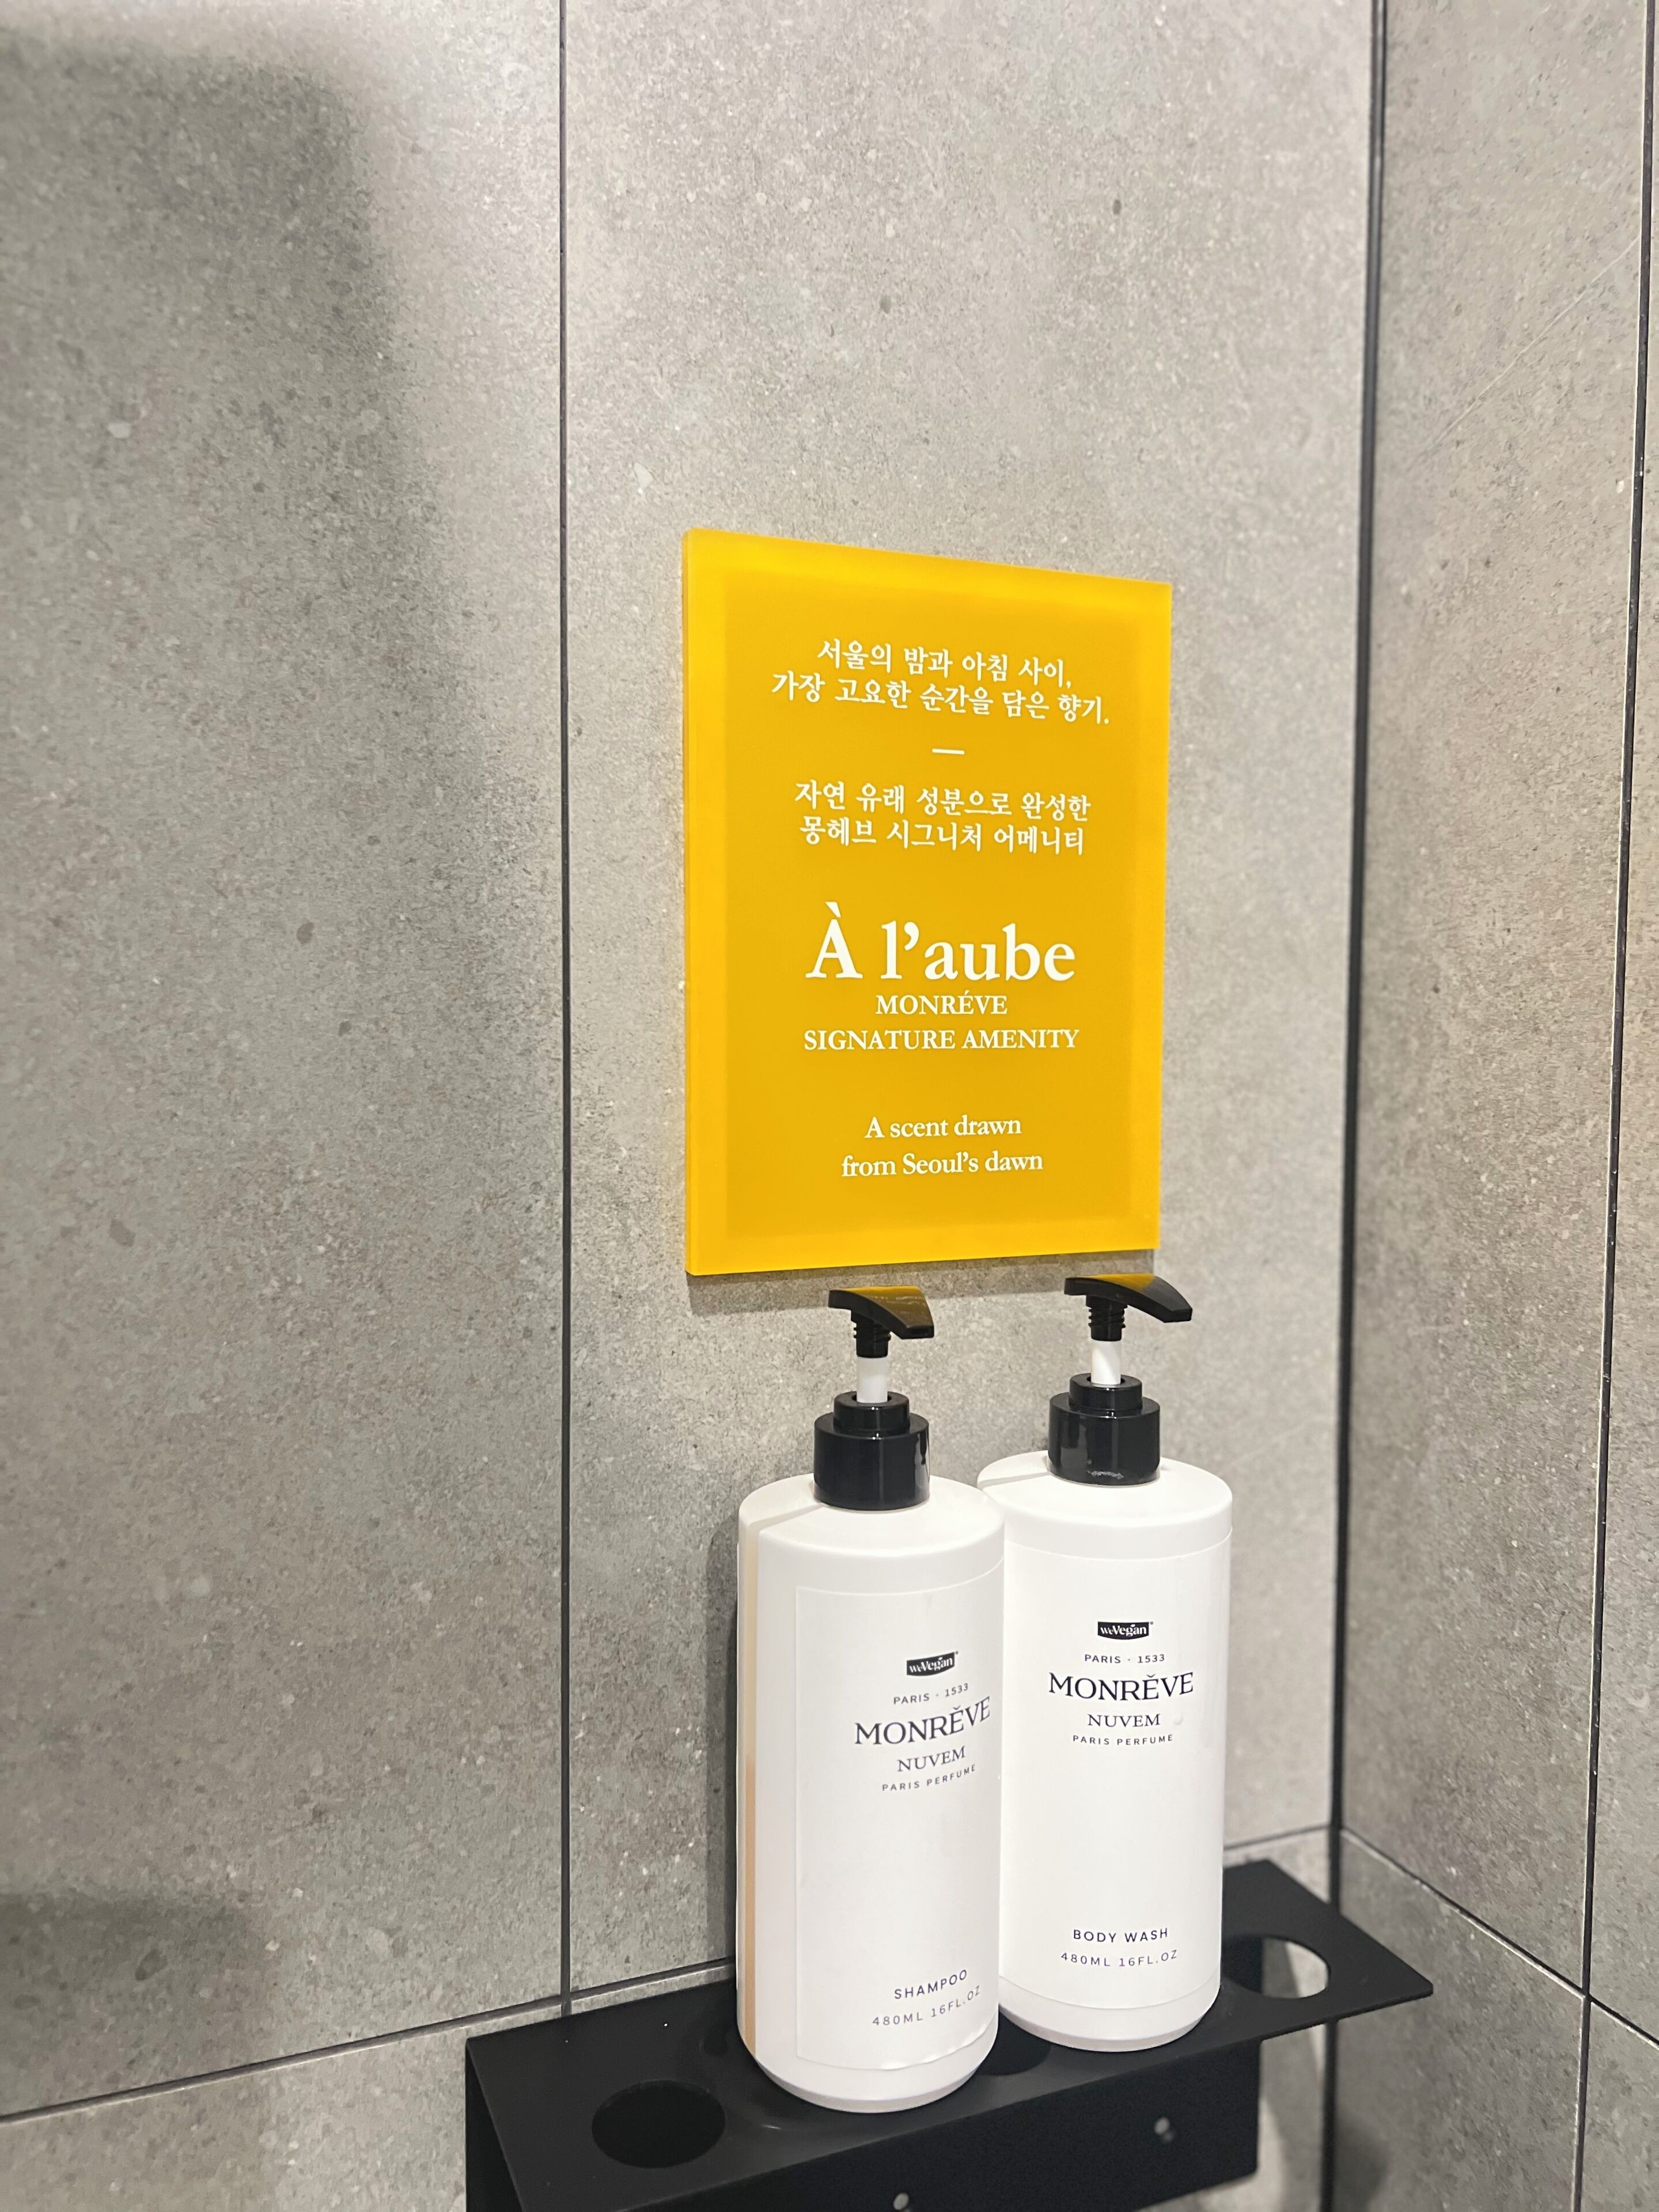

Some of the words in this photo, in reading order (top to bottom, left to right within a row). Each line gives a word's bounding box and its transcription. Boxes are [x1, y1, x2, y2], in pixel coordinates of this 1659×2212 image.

[817, 638, 892, 673] 서울의
[904, 646, 953, 677] 밤과
[962, 652, 1008, 682] 아침
[1018, 657, 1071, 688] 사이,
[772, 670, 825, 701] 가장
[835, 679, 912, 709] 고요한
[920, 683, 994, 715] 순간을
[1002, 690, 1050, 720] 담은
[1058, 694, 1109, 724] 향기.
[795, 779, 844, 810] 자연
[856, 783, 905, 813] 유래
[916, 786, 1012, 816] 성분으로
[1021, 792, 1091, 821] 완성한
[800, 816, 877, 846] 몽헤브
[887, 820, 982, 851] 시그니처
[994, 824, 1084, 856] 어메니티
[805, 901, 863, 979] À
[876, 990, 1007, 1015] MONRÉVE
[804, 1029, 956, 1050] SIGNATURE
[961, 1029, 1079, 1050] AMENITY
[865, 1116, 885, 1138] A
[890, 1120, 948, 1138] scent
[954, 1114, 1021, 1136] drawn
[842, 1155, 897, 1177] from
[903, 1152, 979, 1175] Seoul’s
[984, 1150, 1043, 1172] dawn
[1084, 1654, 1122, 1664] PARIS
[1137, 1654, 1165, 1664] 1533
[893, 1693, 930, 1705] PARIS
[945, 1683, 969, 1698] 1533
[1087, 1713, 1161, 1729] NUVEM
[1073, 1734, 1110, 1746] PARIS
[1116, 1733, 1173, 1747] PERFUME
[897, 1745, 967, 1772] NUVEM
[882, 1781, 920, 1792] PARIS
[926, 1764, 976, 1787] PERFUME
[1073, 1929, 1117, 1944] BODY
[1124, 1927, 1168, 1944] WASH
[1060, 1952, 1111, 1967] 480ML
[1119, 1949, 1178, 1968] 16FL.OZ
[894, 1969, 968, 2000] SHAMPOO
[872, 2013, 923, 2027] 480ML
[931, 1985, 980, 2018] 16FL.OZ
